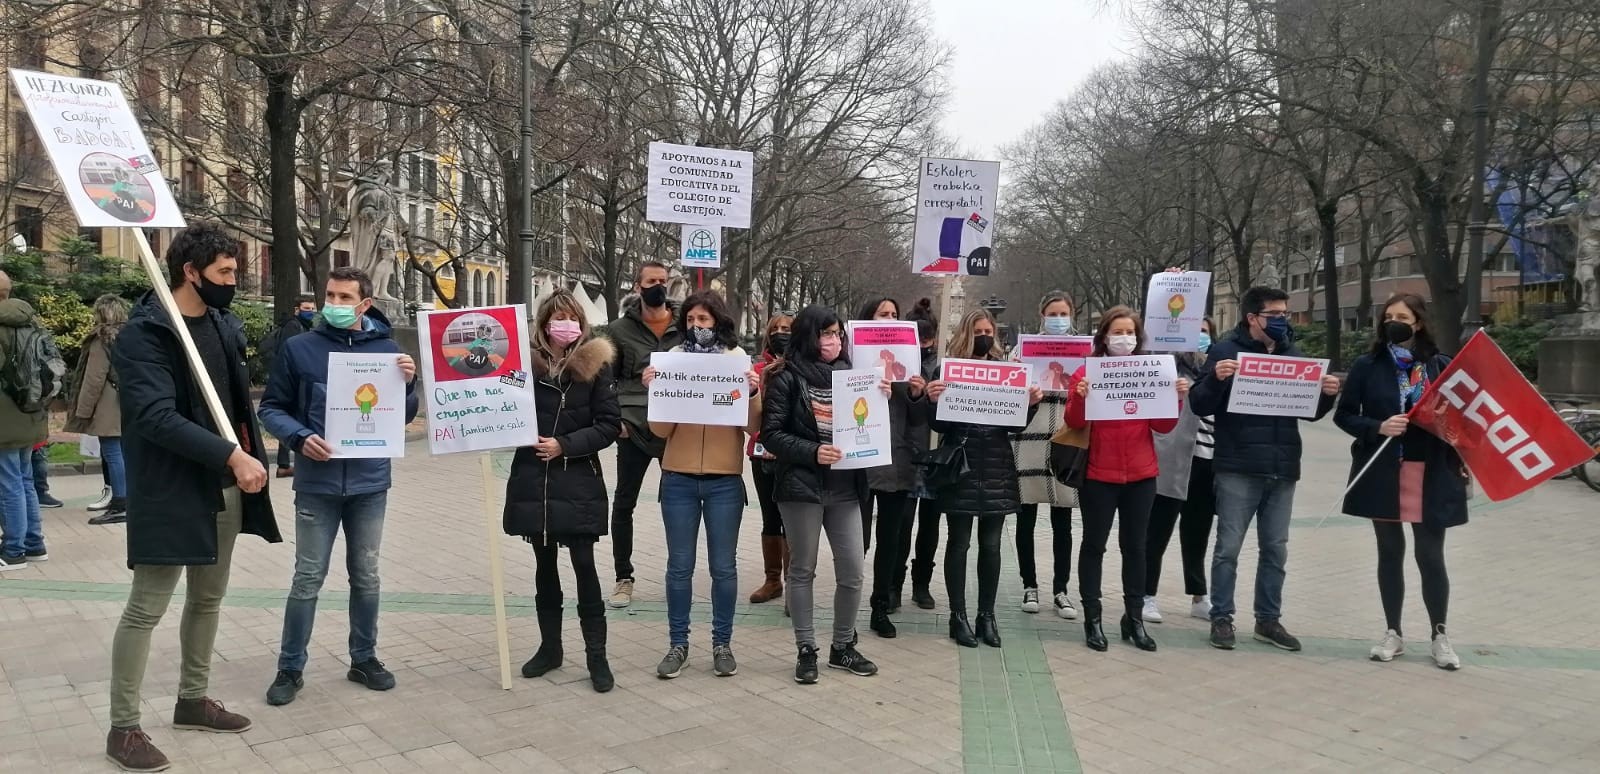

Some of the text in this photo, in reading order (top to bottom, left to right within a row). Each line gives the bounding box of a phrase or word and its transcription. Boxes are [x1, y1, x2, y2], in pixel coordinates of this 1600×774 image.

[25, 76, 112, 97] HEZKUNTZA
[661, 152, 742, 169] APOYAMOS A LA
[669, 166, 734, 180] COMUNIDAD
[926, 162, 977, 178] Eskolen
[660, 178, 741, 193] EDUCATIVA DEL
[118, 198, 135, 210] PAI
[668, 191, 732, 205] COLEGIO DE
[673, 204, 727, 217] CASTEJÓN.
[685, 248, 717, 259] ANPE
[970, 258, 987, 268] PAI
[469, 353, 486, 364] PAI
[1100, 361, 1140, 369] RESPETO
[1245, 360, 1297, 376] CCOO
[654, 372, 744, 384] PAI-tik ateratzeko
[949, 366, 1000, 382] CCOO
[1103, 370, 1145, 379] DECISIÓN
[1091, 380, 1138, 389] CASTEJÓN
[434, 387, 504, 406] Que no nos
[653, 389, 705, 399] eskubidea
[714, 394, 732, 402] LAB
[1106, 392, 1156, 400] ALUMNADO
[500, 401, 518, 412] del
[496, 424, 505, 432] se
[507, 417, 526, 430] sale
[1438, 368, 1555, 480] CCOO
